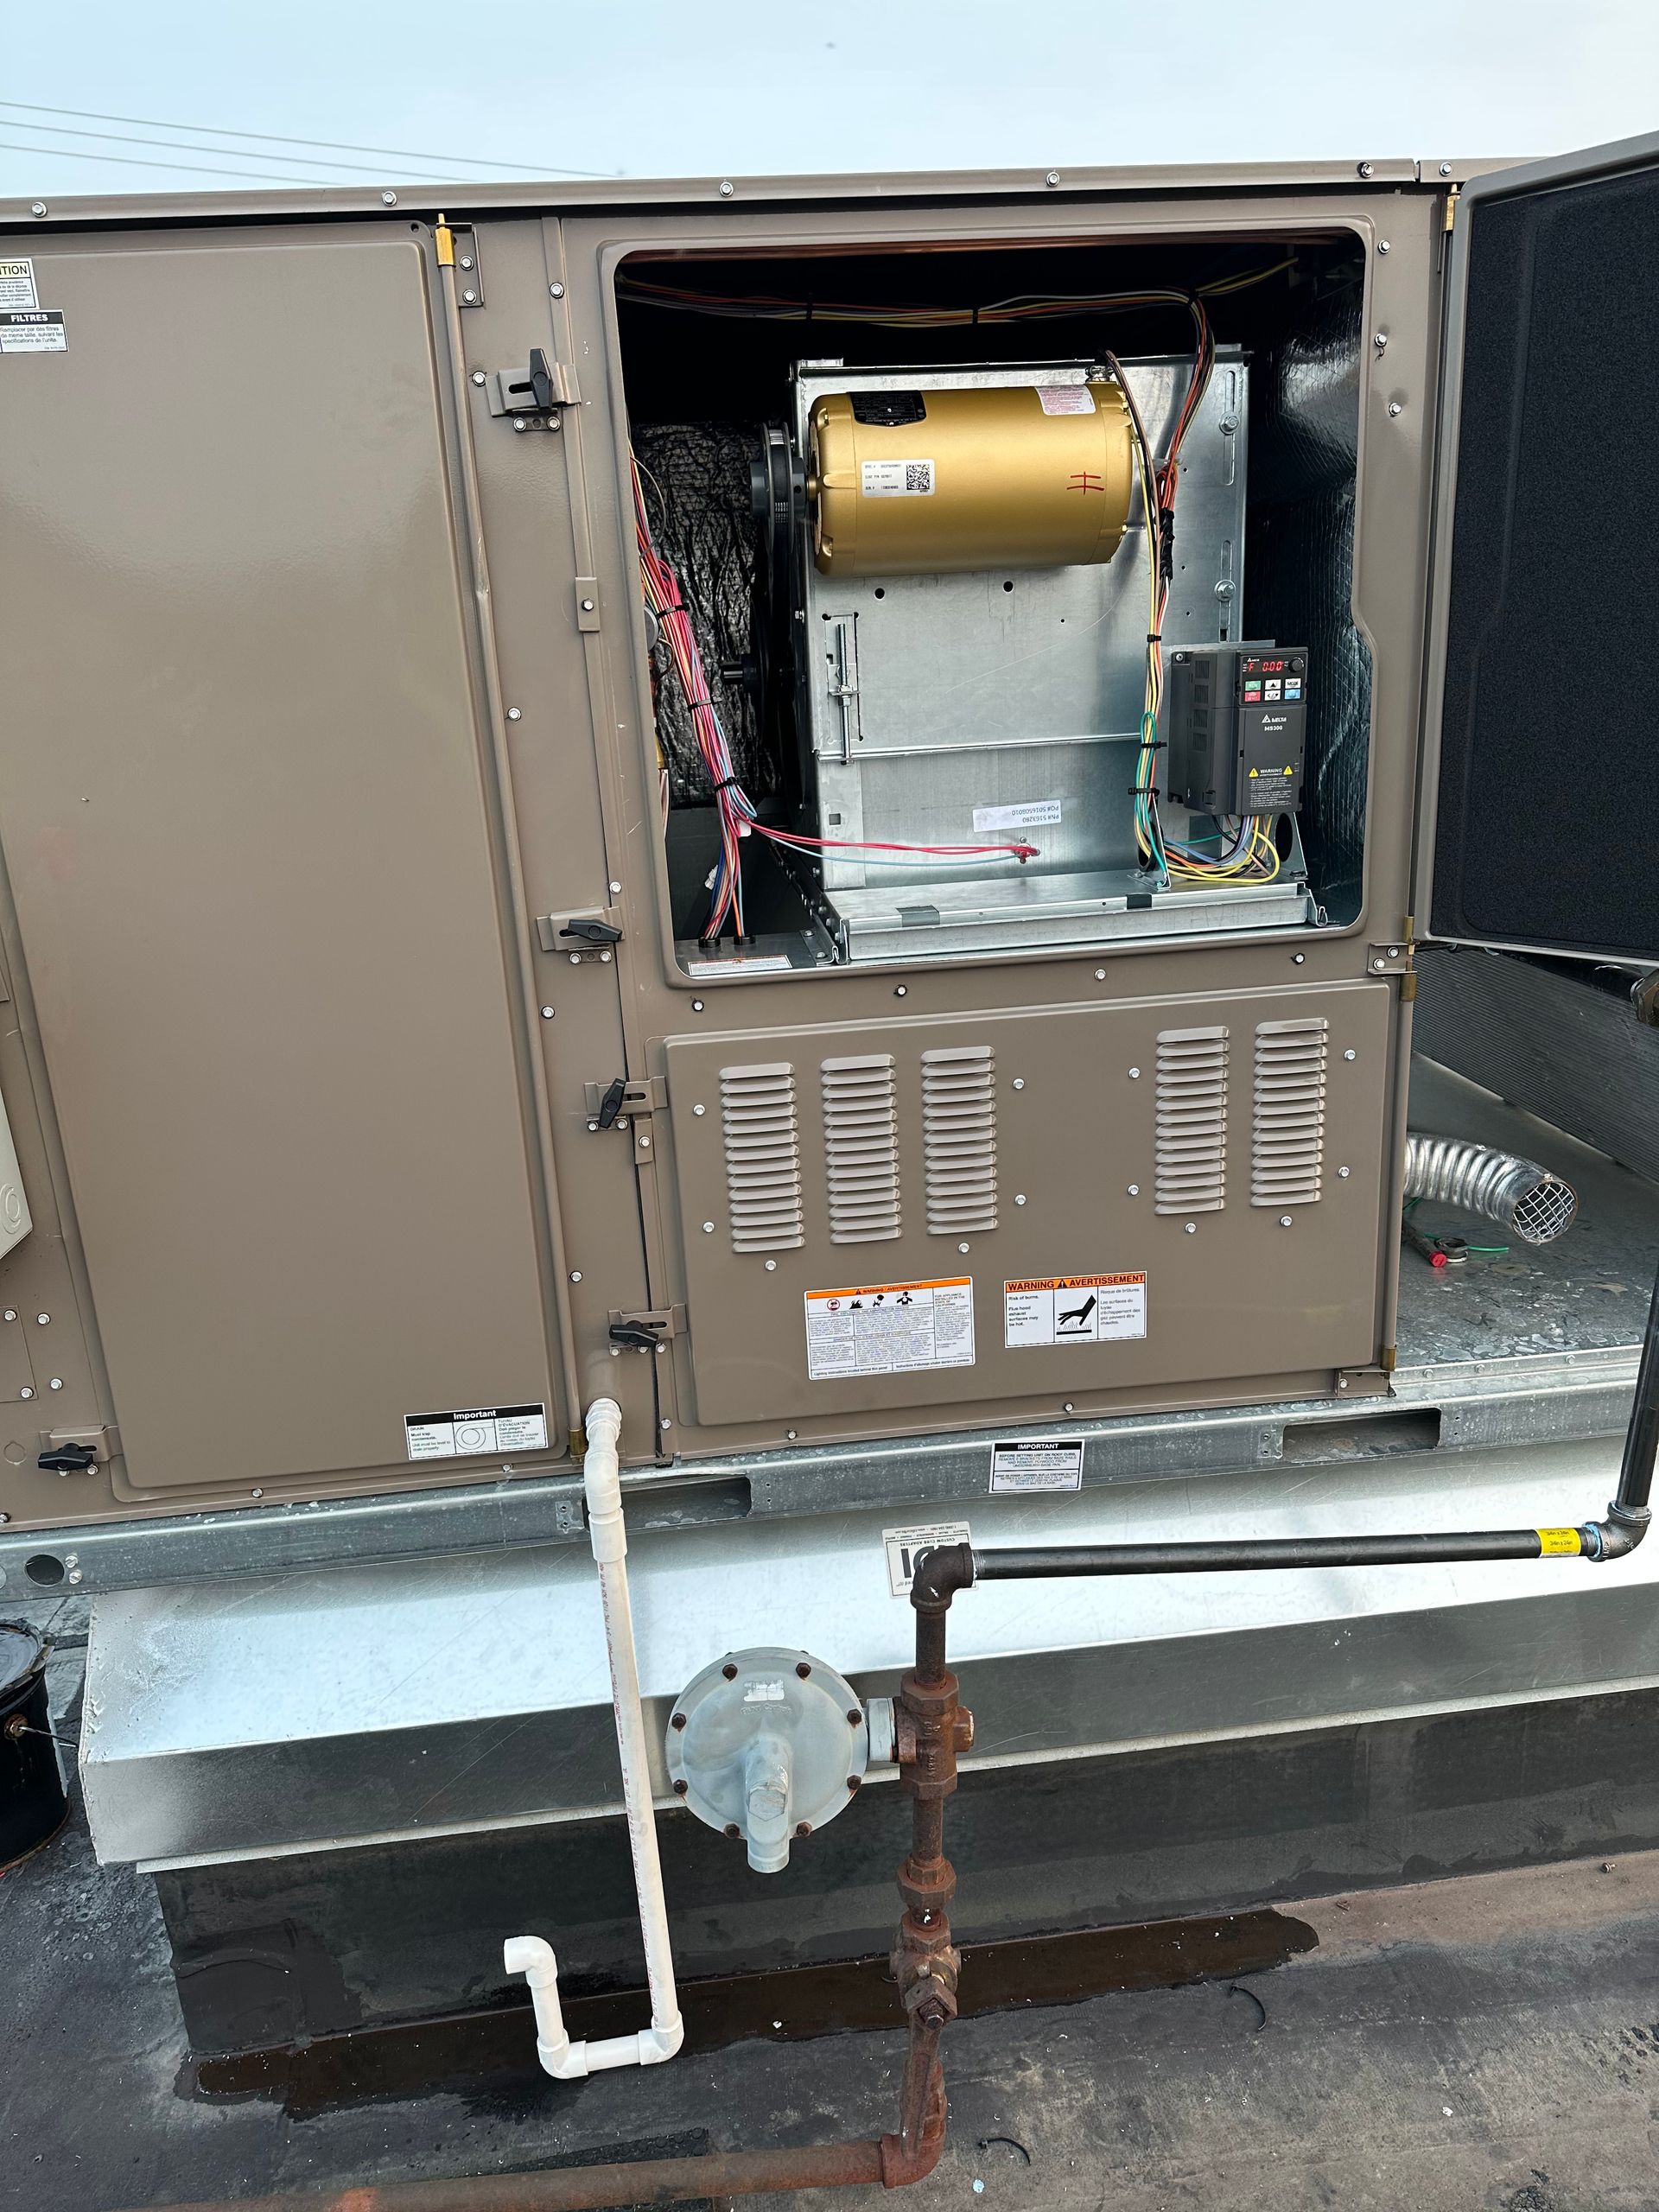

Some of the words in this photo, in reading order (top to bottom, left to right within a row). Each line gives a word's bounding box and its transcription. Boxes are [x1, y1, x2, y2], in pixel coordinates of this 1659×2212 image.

[0, 265, 28, 275] TION
[10, 314, 48, 322] FILTRES
[1007, 1281, 1054, 1291] WARNING
[1069, 1274, 1144, 1287] AVERTISSEMENT
[453, 1409, 497, 1421] Important
